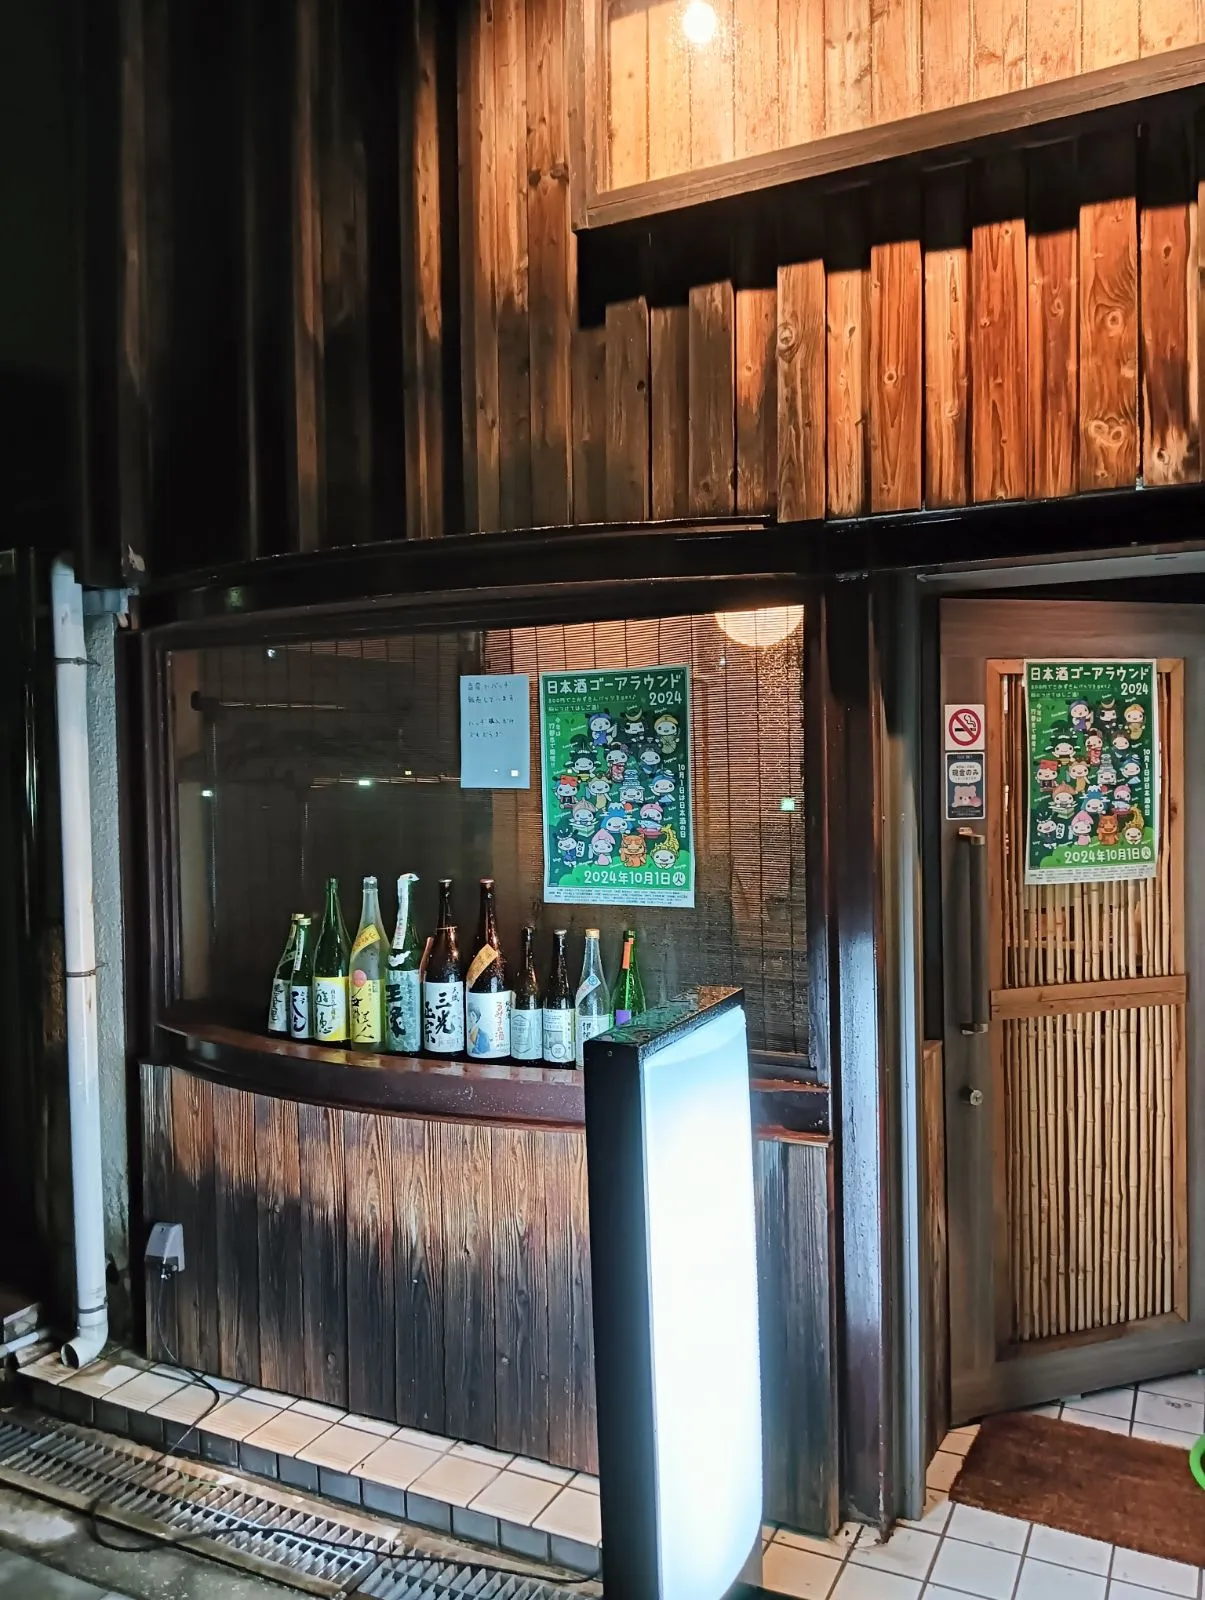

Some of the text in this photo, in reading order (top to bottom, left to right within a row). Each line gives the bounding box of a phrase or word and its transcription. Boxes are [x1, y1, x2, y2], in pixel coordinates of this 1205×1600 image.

[1031, 666, 1149, 681] 日本酒ゴーアラウンド
[547, 673, 681, 694] 日本酒ゴーアラウンド
[1121, 682, 1149, 696] 2024
[649, 691, 682, 706] 2024
[952, 769, 979, 777] 現金のみ
[435, 991, 455, 1034] 三光
